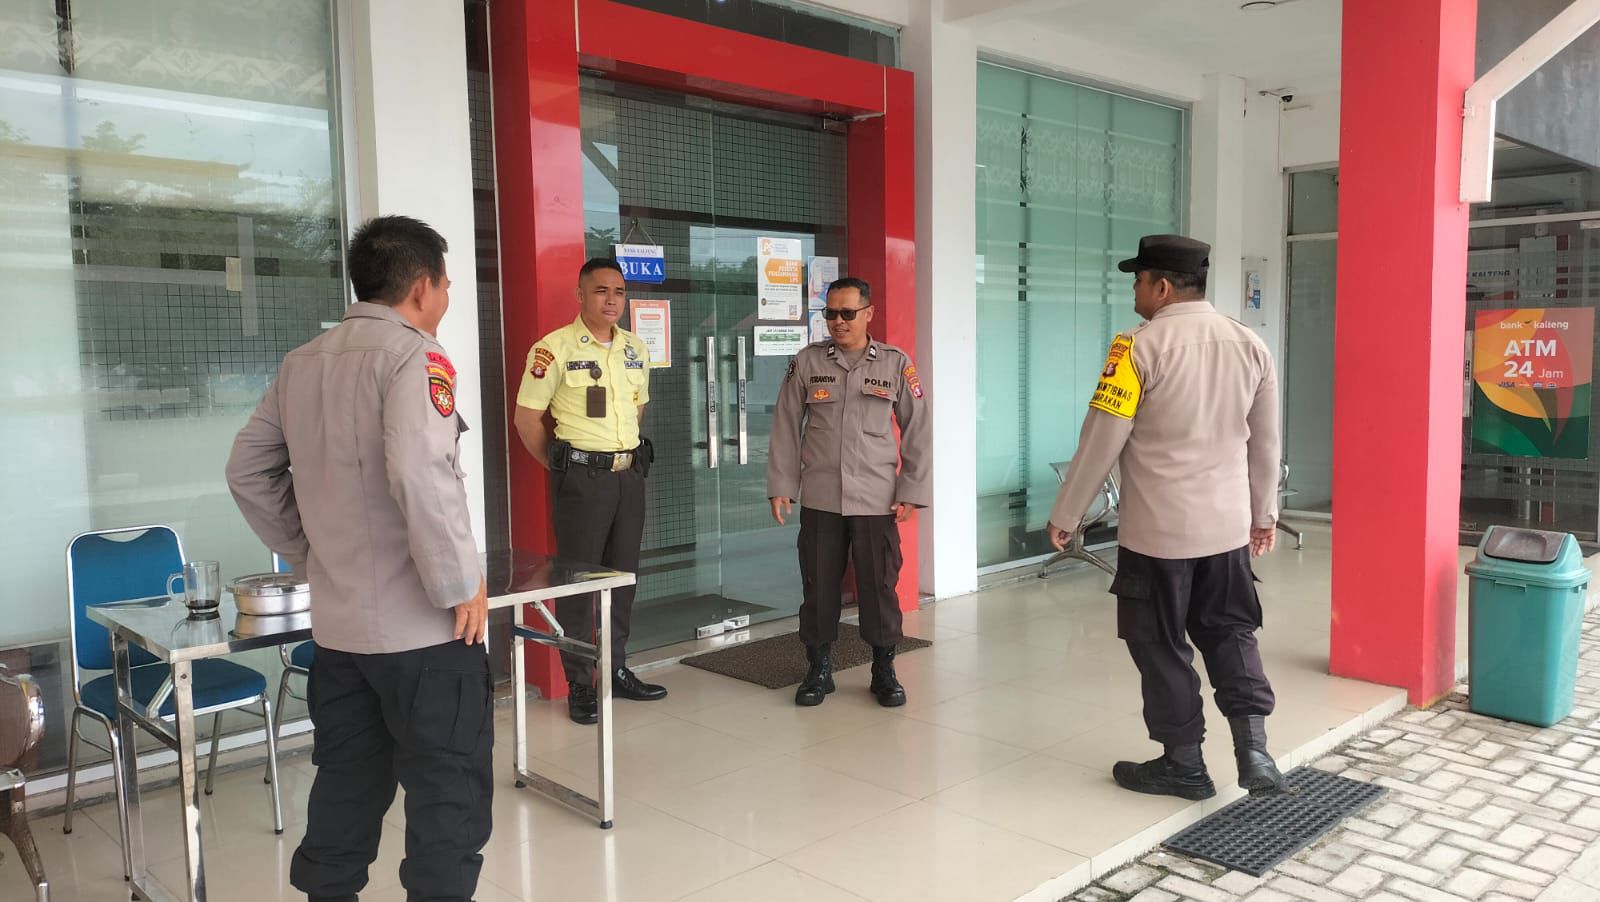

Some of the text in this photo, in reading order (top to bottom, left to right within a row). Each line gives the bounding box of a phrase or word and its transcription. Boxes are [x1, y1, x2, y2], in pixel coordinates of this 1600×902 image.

[619, 261, 663, 276] BUKA
[1500, 320, 1569, 330] bank kalteng
[1503, 339, 1557, 357] ATM
[1503, 360, 1564, 378] 24 Jam
[864, 378, 892, 389] POLRI
